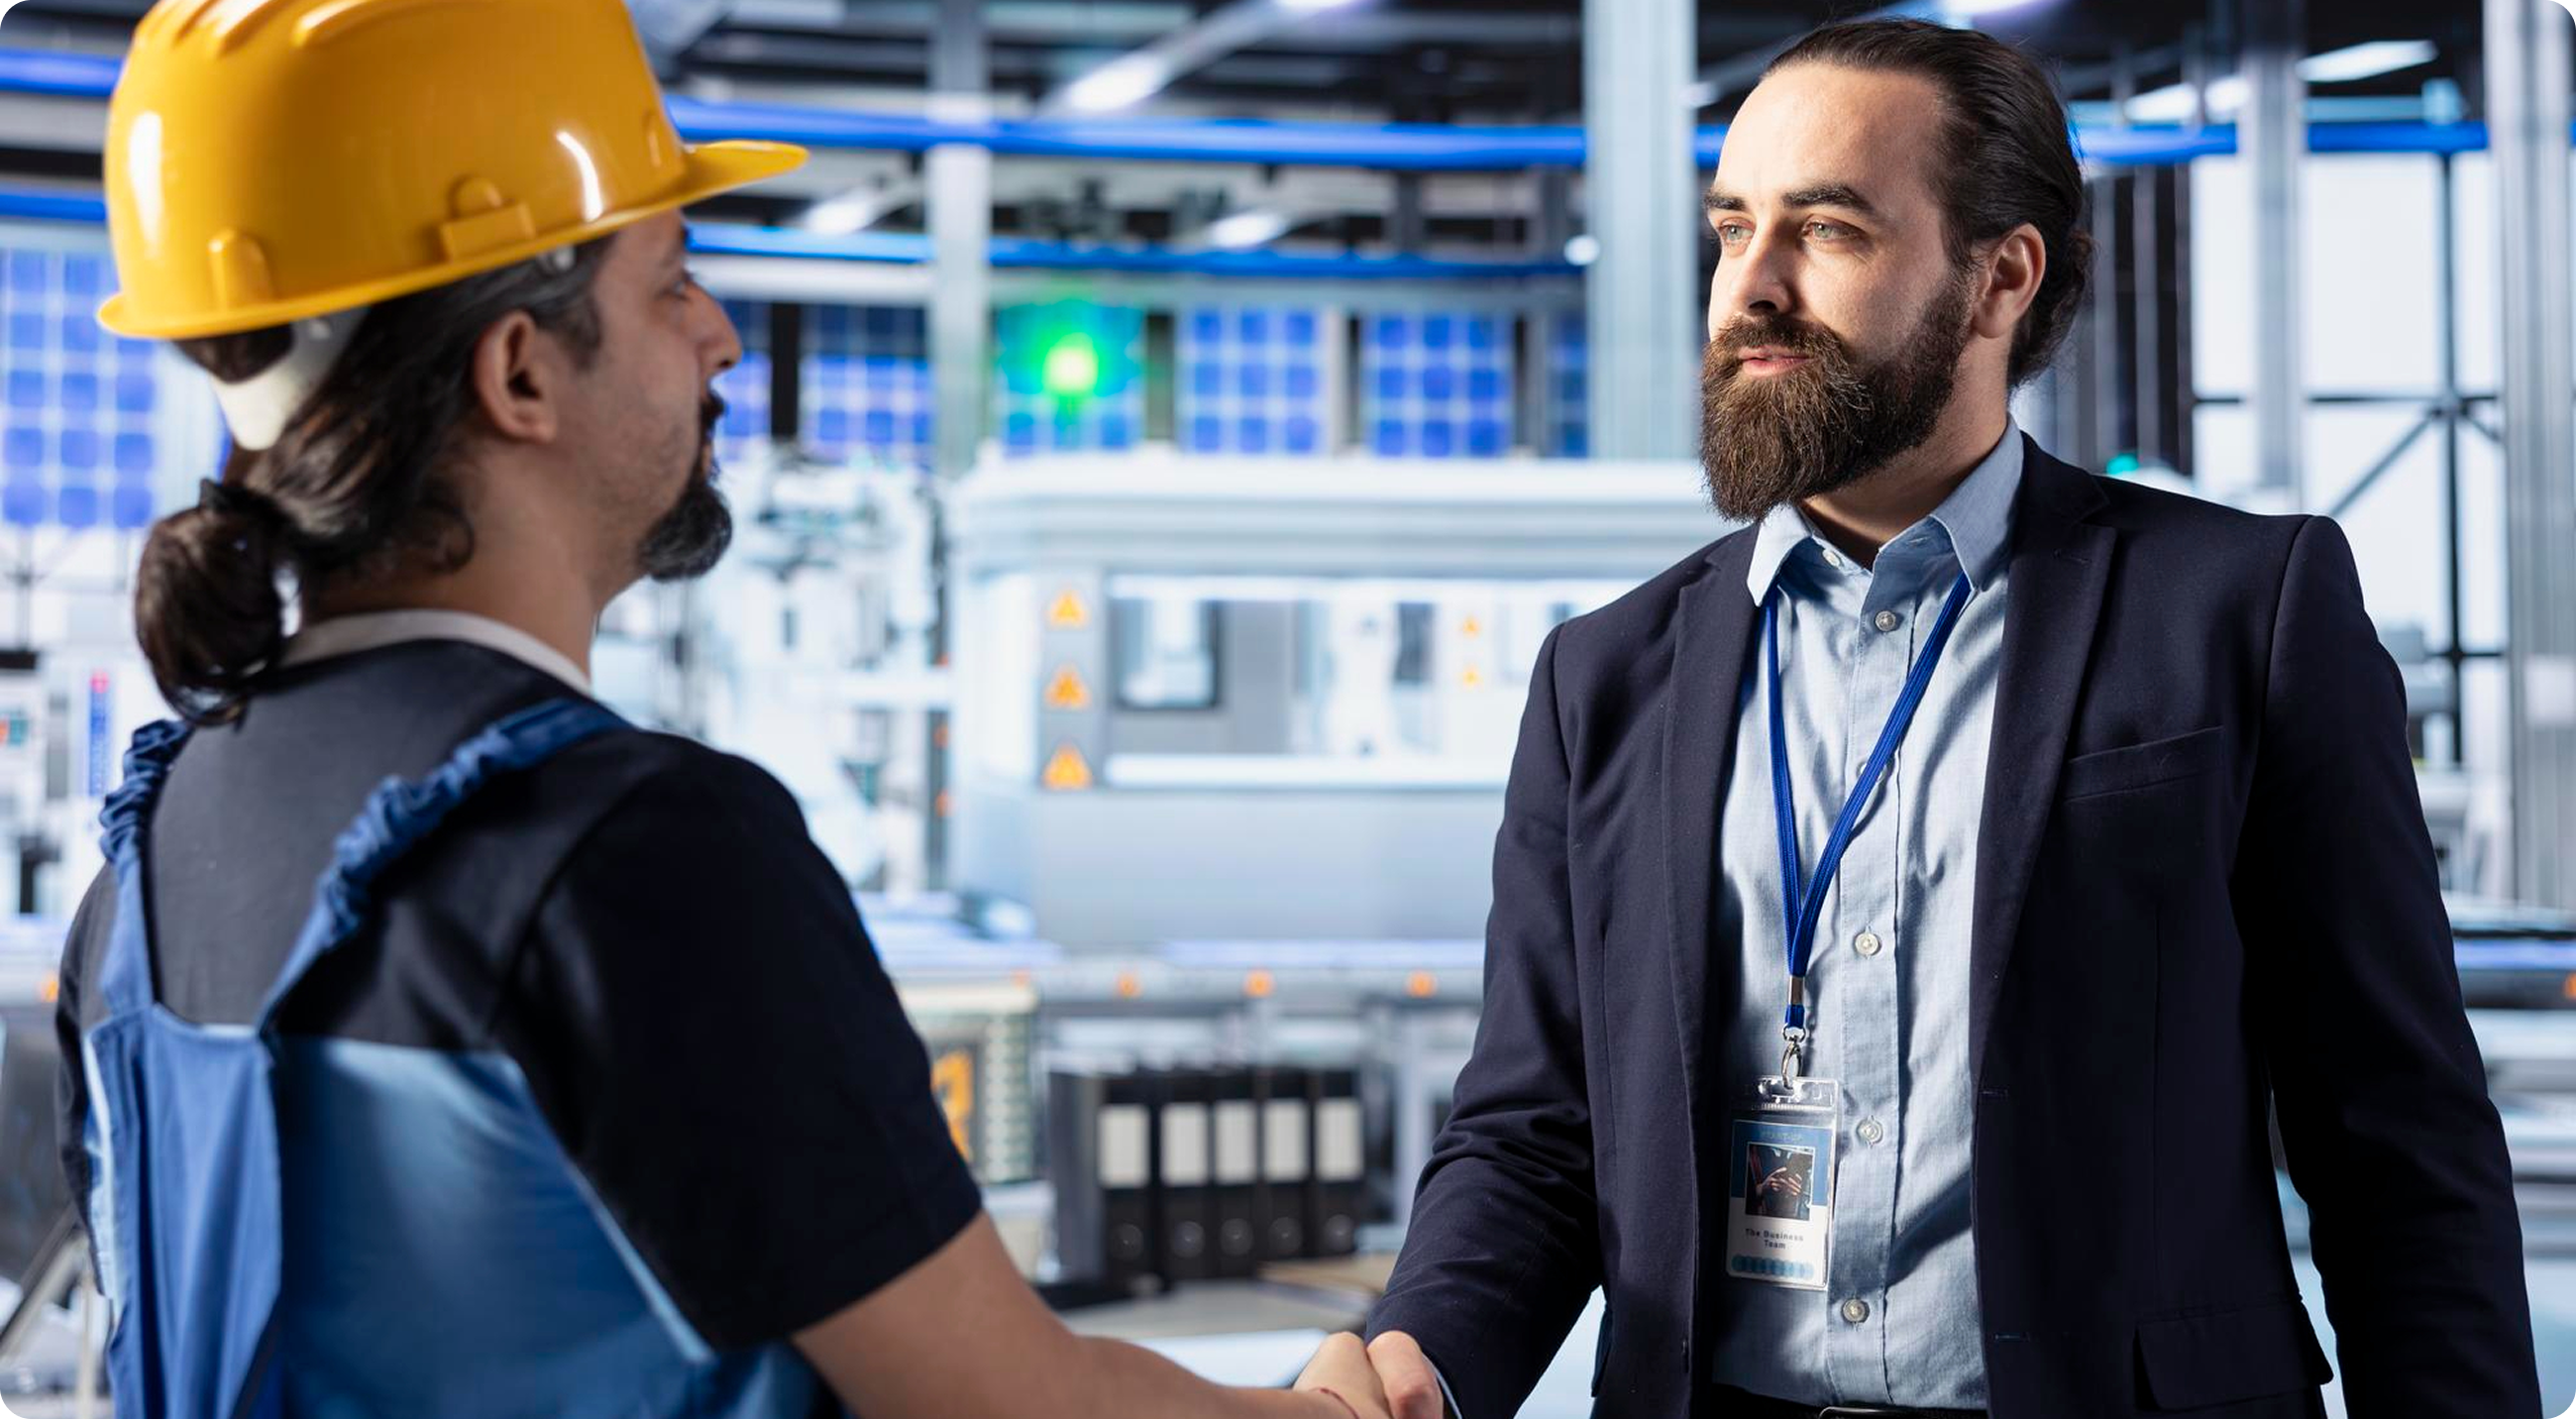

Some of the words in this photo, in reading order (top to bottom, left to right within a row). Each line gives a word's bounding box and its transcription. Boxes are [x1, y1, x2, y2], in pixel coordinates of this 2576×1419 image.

[1745, 1228, 1761, 1238] The
[1764, 1230, 1804, 1242] Business
[1764, 1239, 1786, 1249] Team
